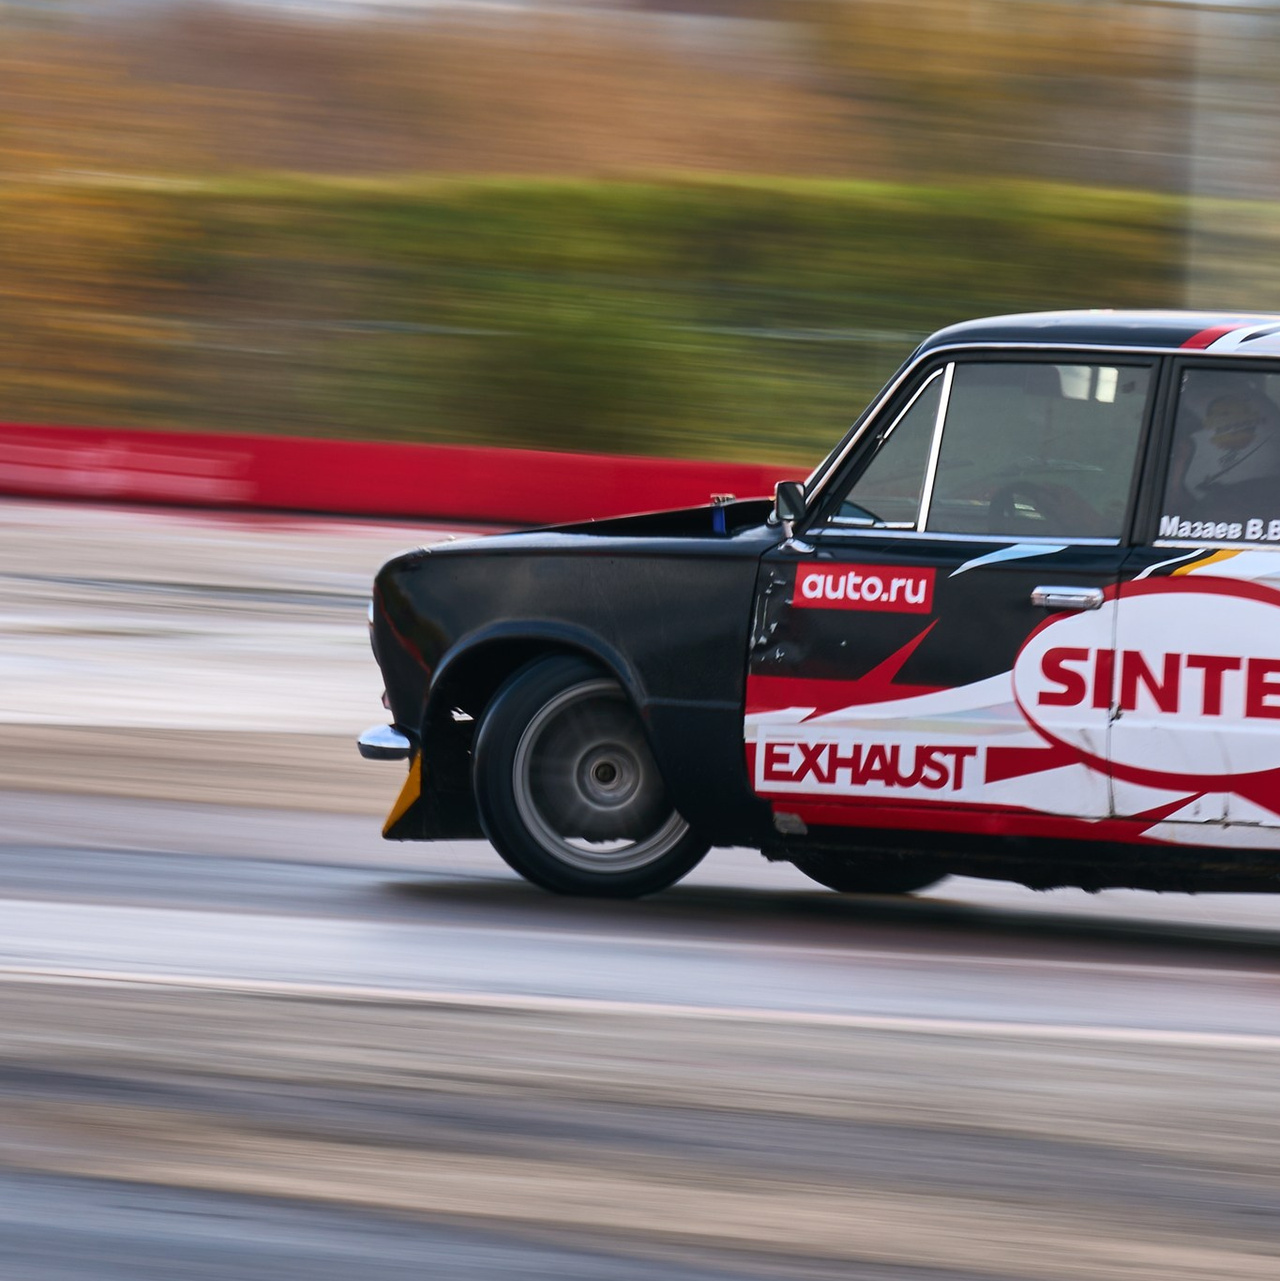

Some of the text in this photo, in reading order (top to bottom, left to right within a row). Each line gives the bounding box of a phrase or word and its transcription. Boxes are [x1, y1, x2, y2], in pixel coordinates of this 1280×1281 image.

[1158, 515, 1243, 539] Мазаев
[801, 571, 928, 605] auto.ru
[763, 742, 978, 792] EXHAUST
